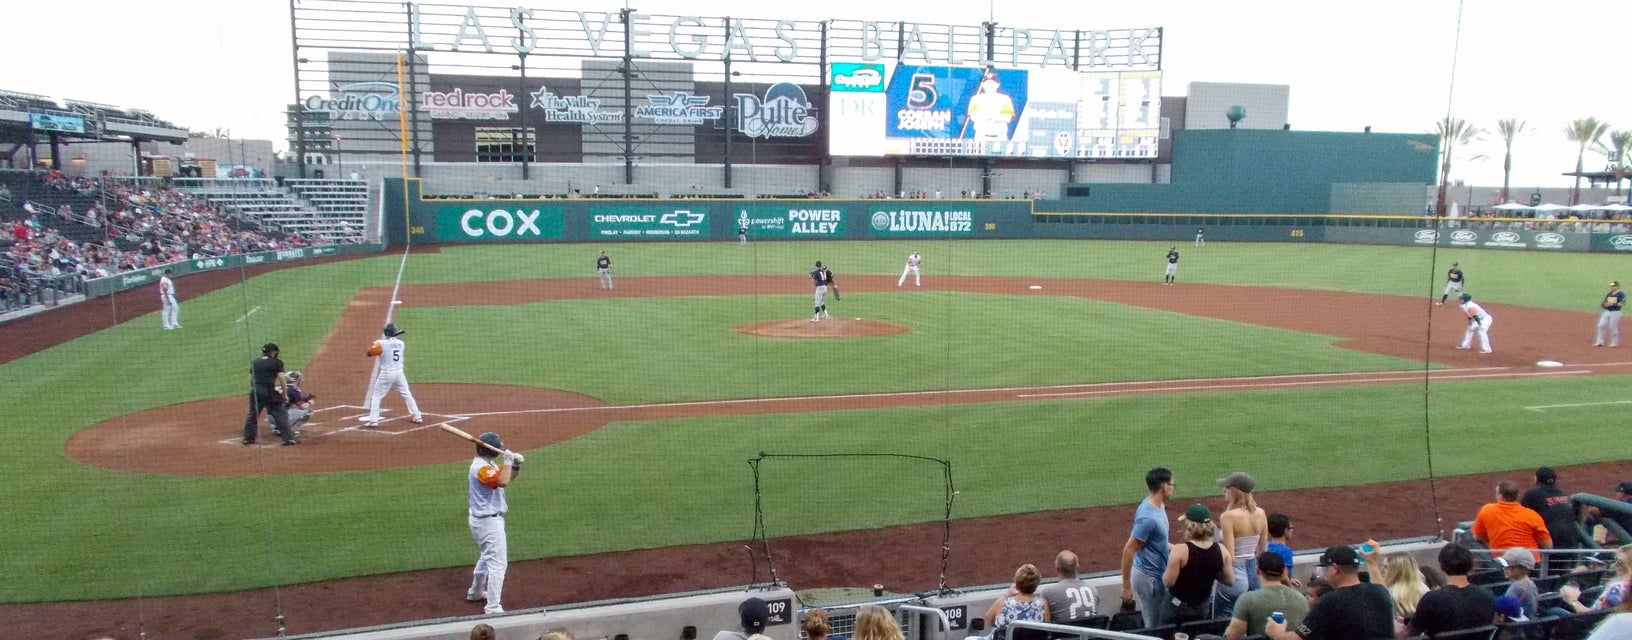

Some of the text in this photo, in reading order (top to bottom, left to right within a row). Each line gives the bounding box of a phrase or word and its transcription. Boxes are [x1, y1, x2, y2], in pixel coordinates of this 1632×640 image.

[413, 4, 538, 53] LAS
[577, 11, 798, 62] VEGAS
[909, 73, 938, 110] 5
[424, 89, 514, 108] red rock
[546, 93, 600, 111] The Valley
[547, 109, 622, 124] Health System
[636, 107, 722, 118] AMERICA FIRST
[735, 94, 806, 131] Pulte
[749, 118, 810, 137] Homes
[595, 214, 656, 222] CHEVROLET
[750, 217, 785, 226] powershift
[789, 209, 841, 221] POWER
[889, 209, 949, 231] LiUNA!
[950, 211, 972, 221] LOCAL
[461, 209, 541, 237] COX
[792, 222, 839, 234] ALLEY
[393, 350, 400, 362] 5
[767, 602, 786, 614] 109
[944, 608, 962, 619] 108
